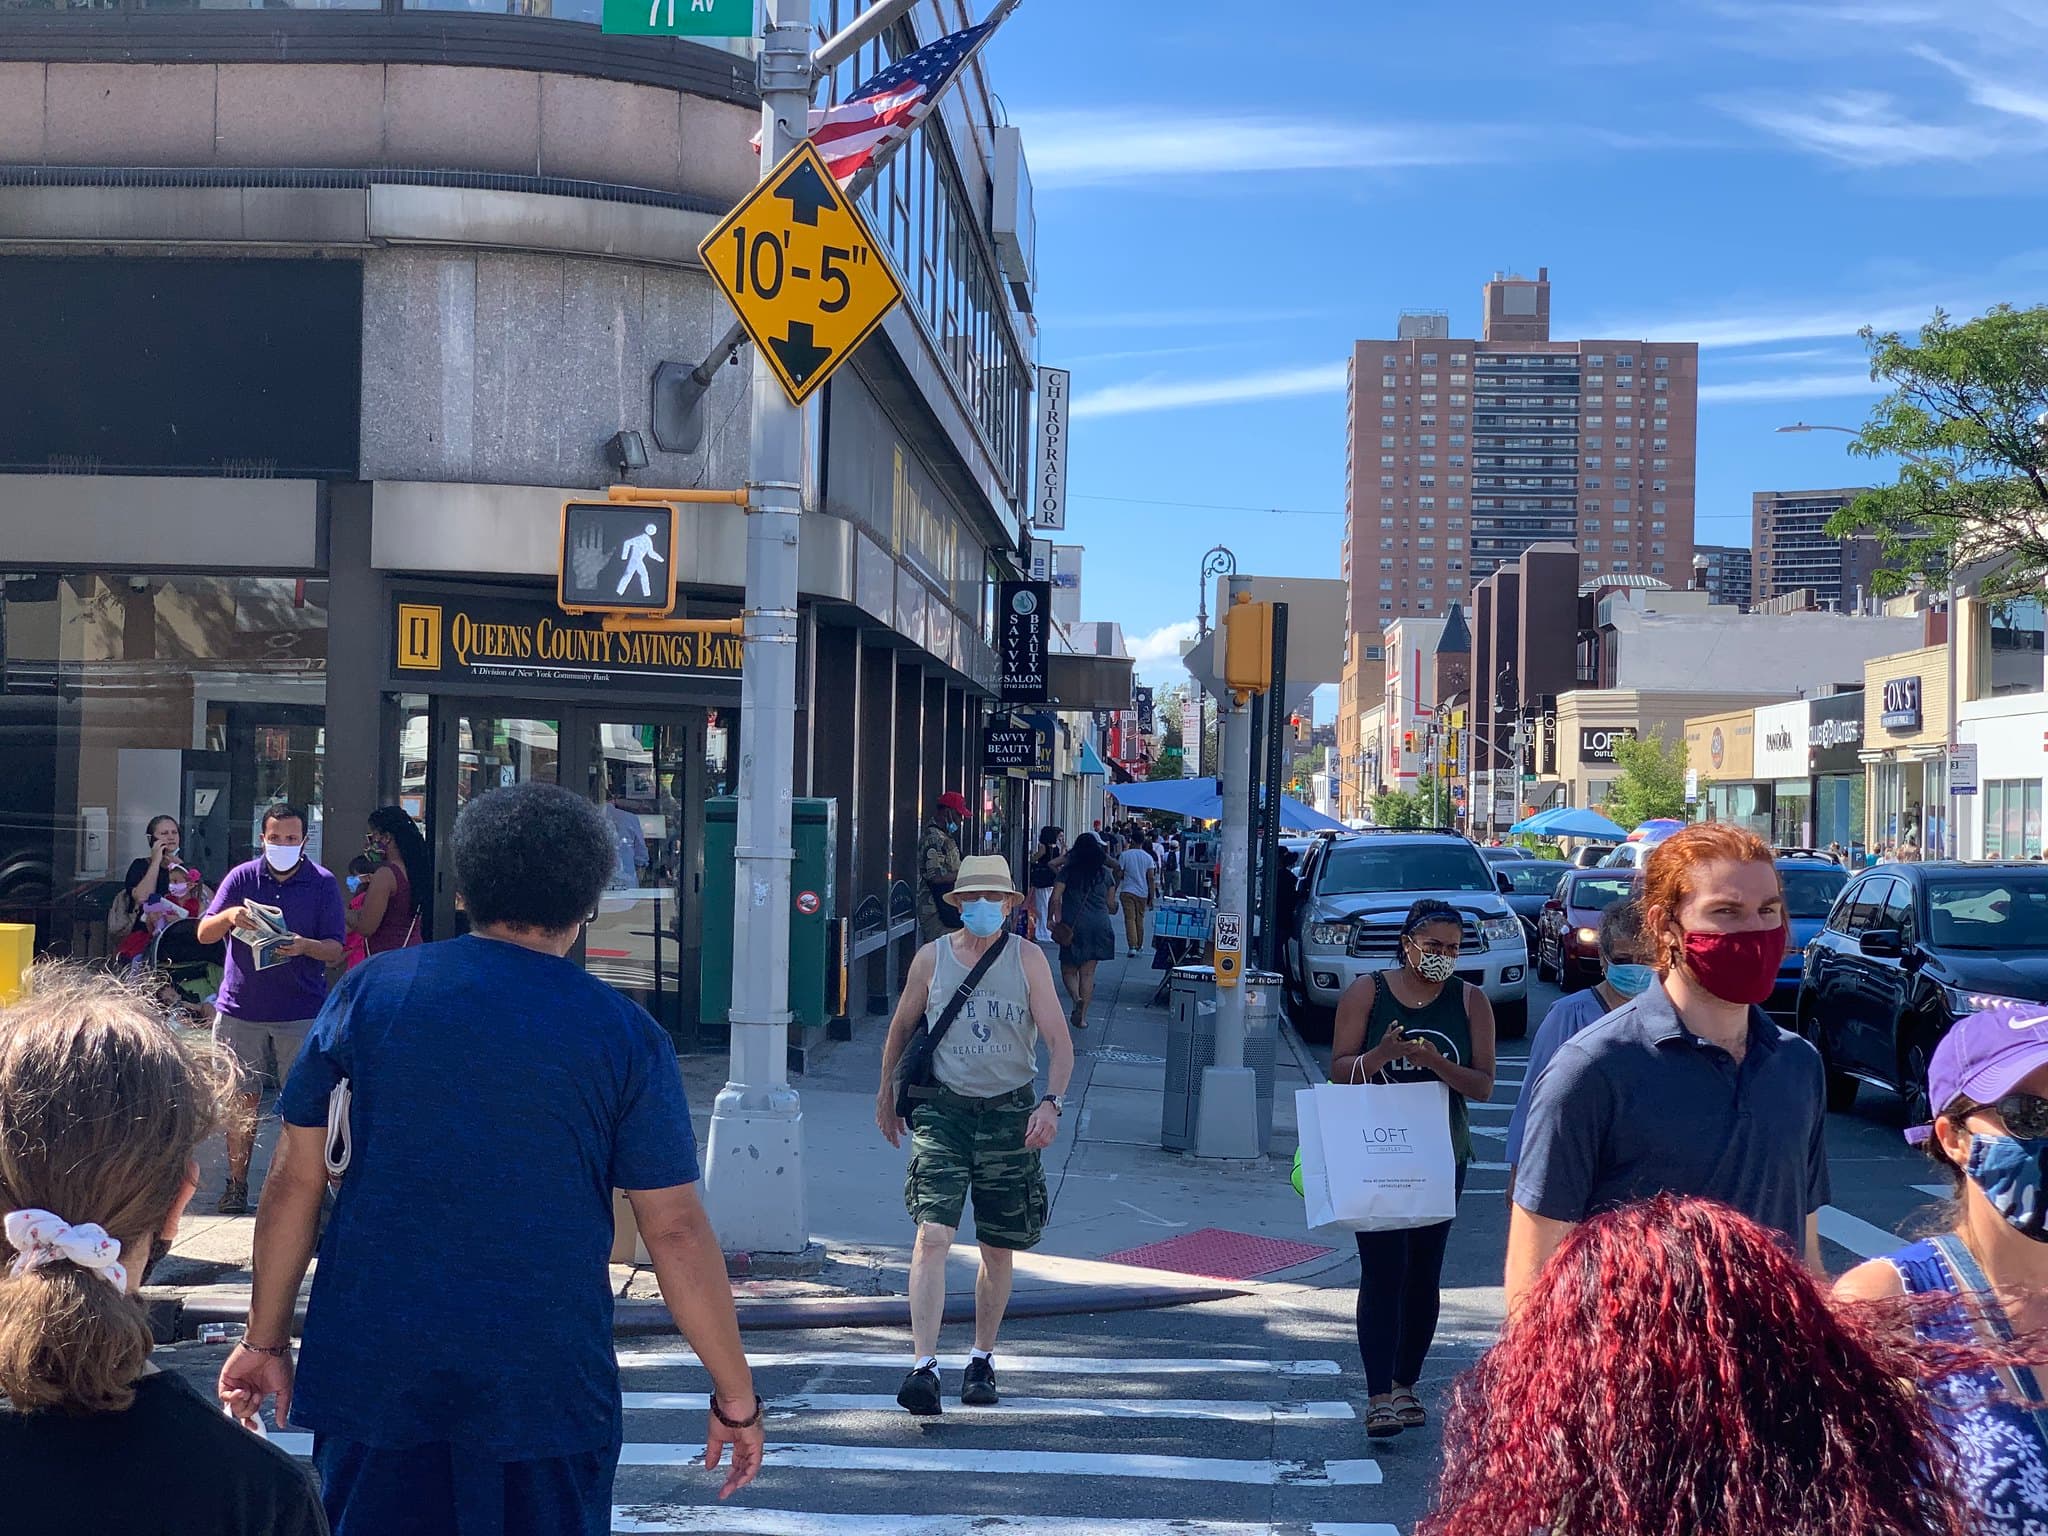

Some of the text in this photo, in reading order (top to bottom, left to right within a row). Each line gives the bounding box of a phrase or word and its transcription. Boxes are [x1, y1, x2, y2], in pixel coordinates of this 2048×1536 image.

[1043, 373, 1061, 524] CHIROPRACTOR
[452, 612, 532, 666] QUEENS
[536, 617, 614, 662] COUNTY
[618, 631, 692, 667] SAVINGS
[1009, 614, 1020, 673] SAVVY
[1028, 614, 1040, 673] BEAUTY
[471, 667, 477, 675] A
[479, 667, 507, 677] Division
[508, 668, 517, 677] of
[517, 669, 534, 678] New
[536, 669, 553, 679] York
[592, 673, 610, 682] Bank
[1003, 674, 1042, 683] SALON
[991, 733, 1027, 742] SAVVY
[1544, 710, 1555, 744] LOFT
[1766, 726, 1793, 752] PANDORA
[988, 744, 1031, 754] BEAUTY
[987, 1000, 1025, 1024] MAY
[1362, 1127, 1408, 1143] LOFT
